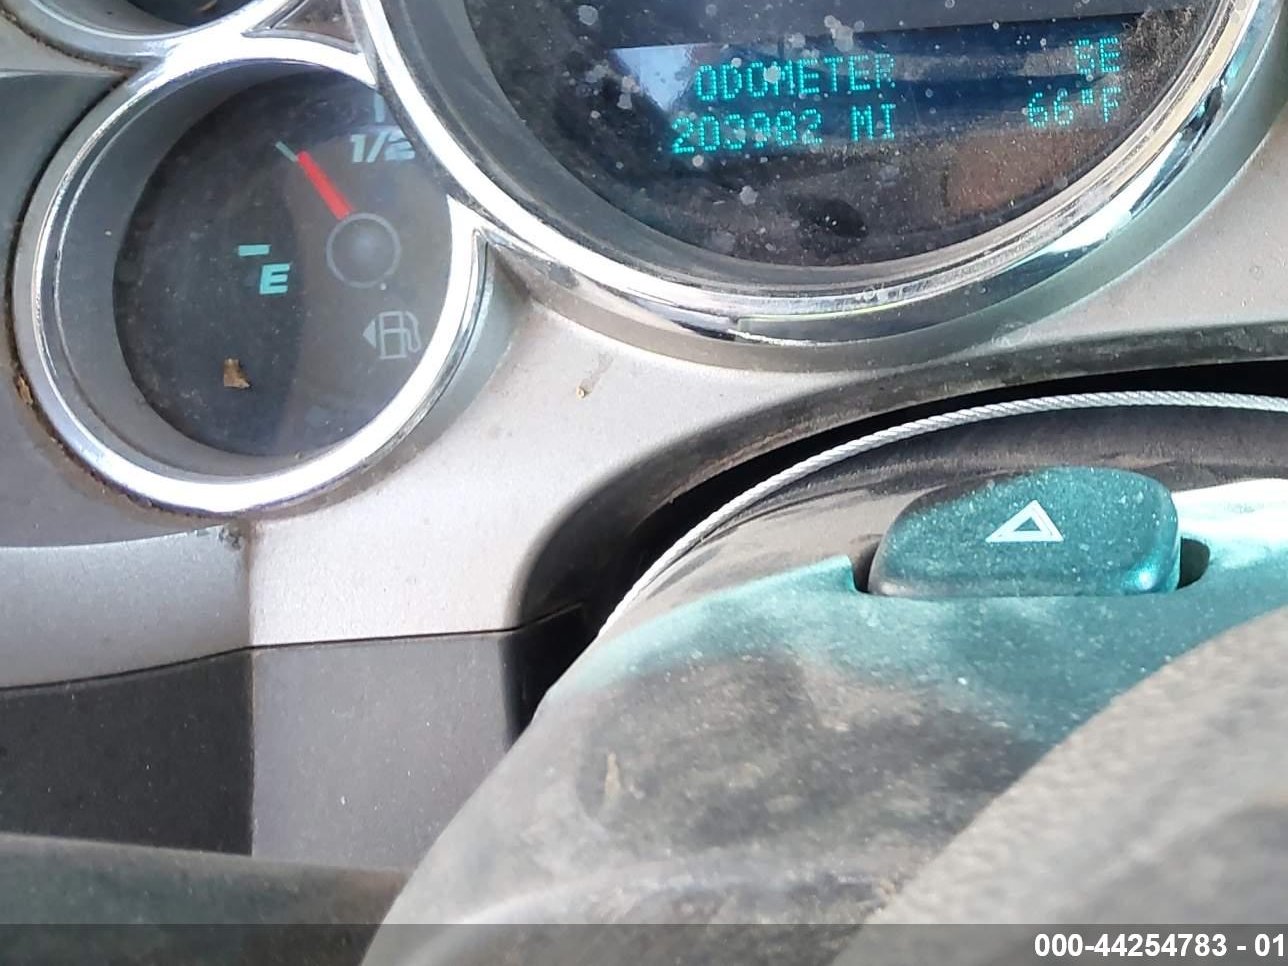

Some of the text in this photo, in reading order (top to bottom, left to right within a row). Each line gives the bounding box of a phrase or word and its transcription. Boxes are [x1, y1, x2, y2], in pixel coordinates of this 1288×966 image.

[1074, 37, 1121, 75] SE
[696, 53, 897, 101] ODOMETER
[851, 103, 897, 142] MI
[350, 129, 416, 164] 1/2
[258, 262, 292, 296] E
